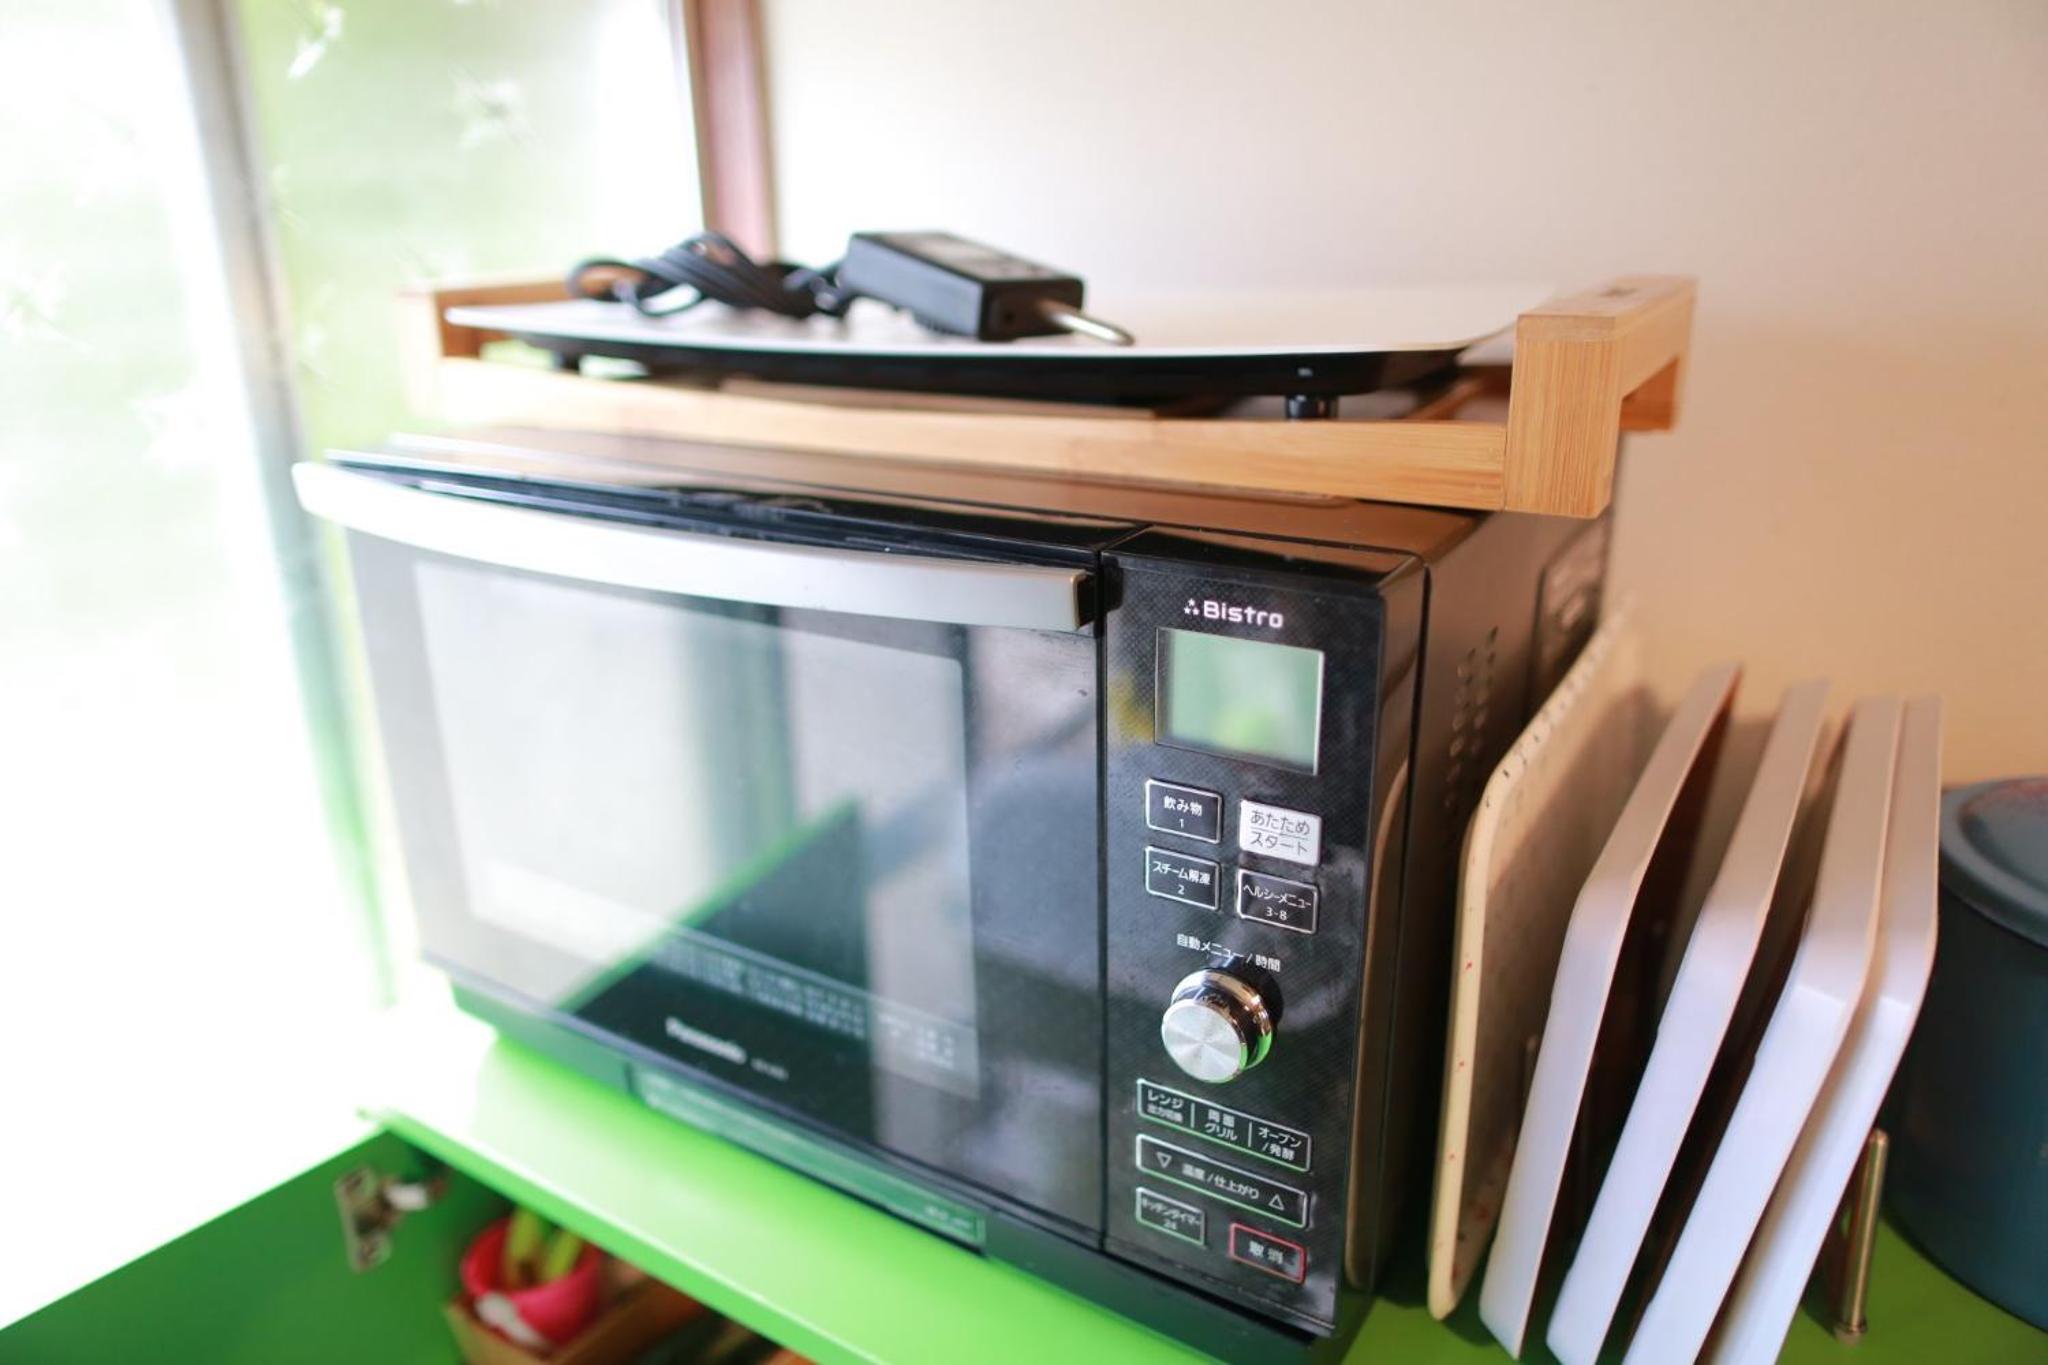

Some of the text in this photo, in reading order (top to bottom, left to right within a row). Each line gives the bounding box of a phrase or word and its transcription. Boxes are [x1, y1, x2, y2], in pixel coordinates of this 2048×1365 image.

[1203, 600, 1284, 629] Bistro
[1163, 795, 1203, 817] 飲み物
[1178, 818, 1185, 828] 1
[1250, 809, 1311, 836] あたため
[1250, 831, 1309, 856] スタート
[1177, 885, 1185, 895] 2
[1243, 885, 1312, 909] ヘルシーメニュー
[1147, 1089, 1184, 1109] レンジ
[1205, 1122, 1238, 1141] グリル
[1258, 1126, 1302, 1149] オープン
